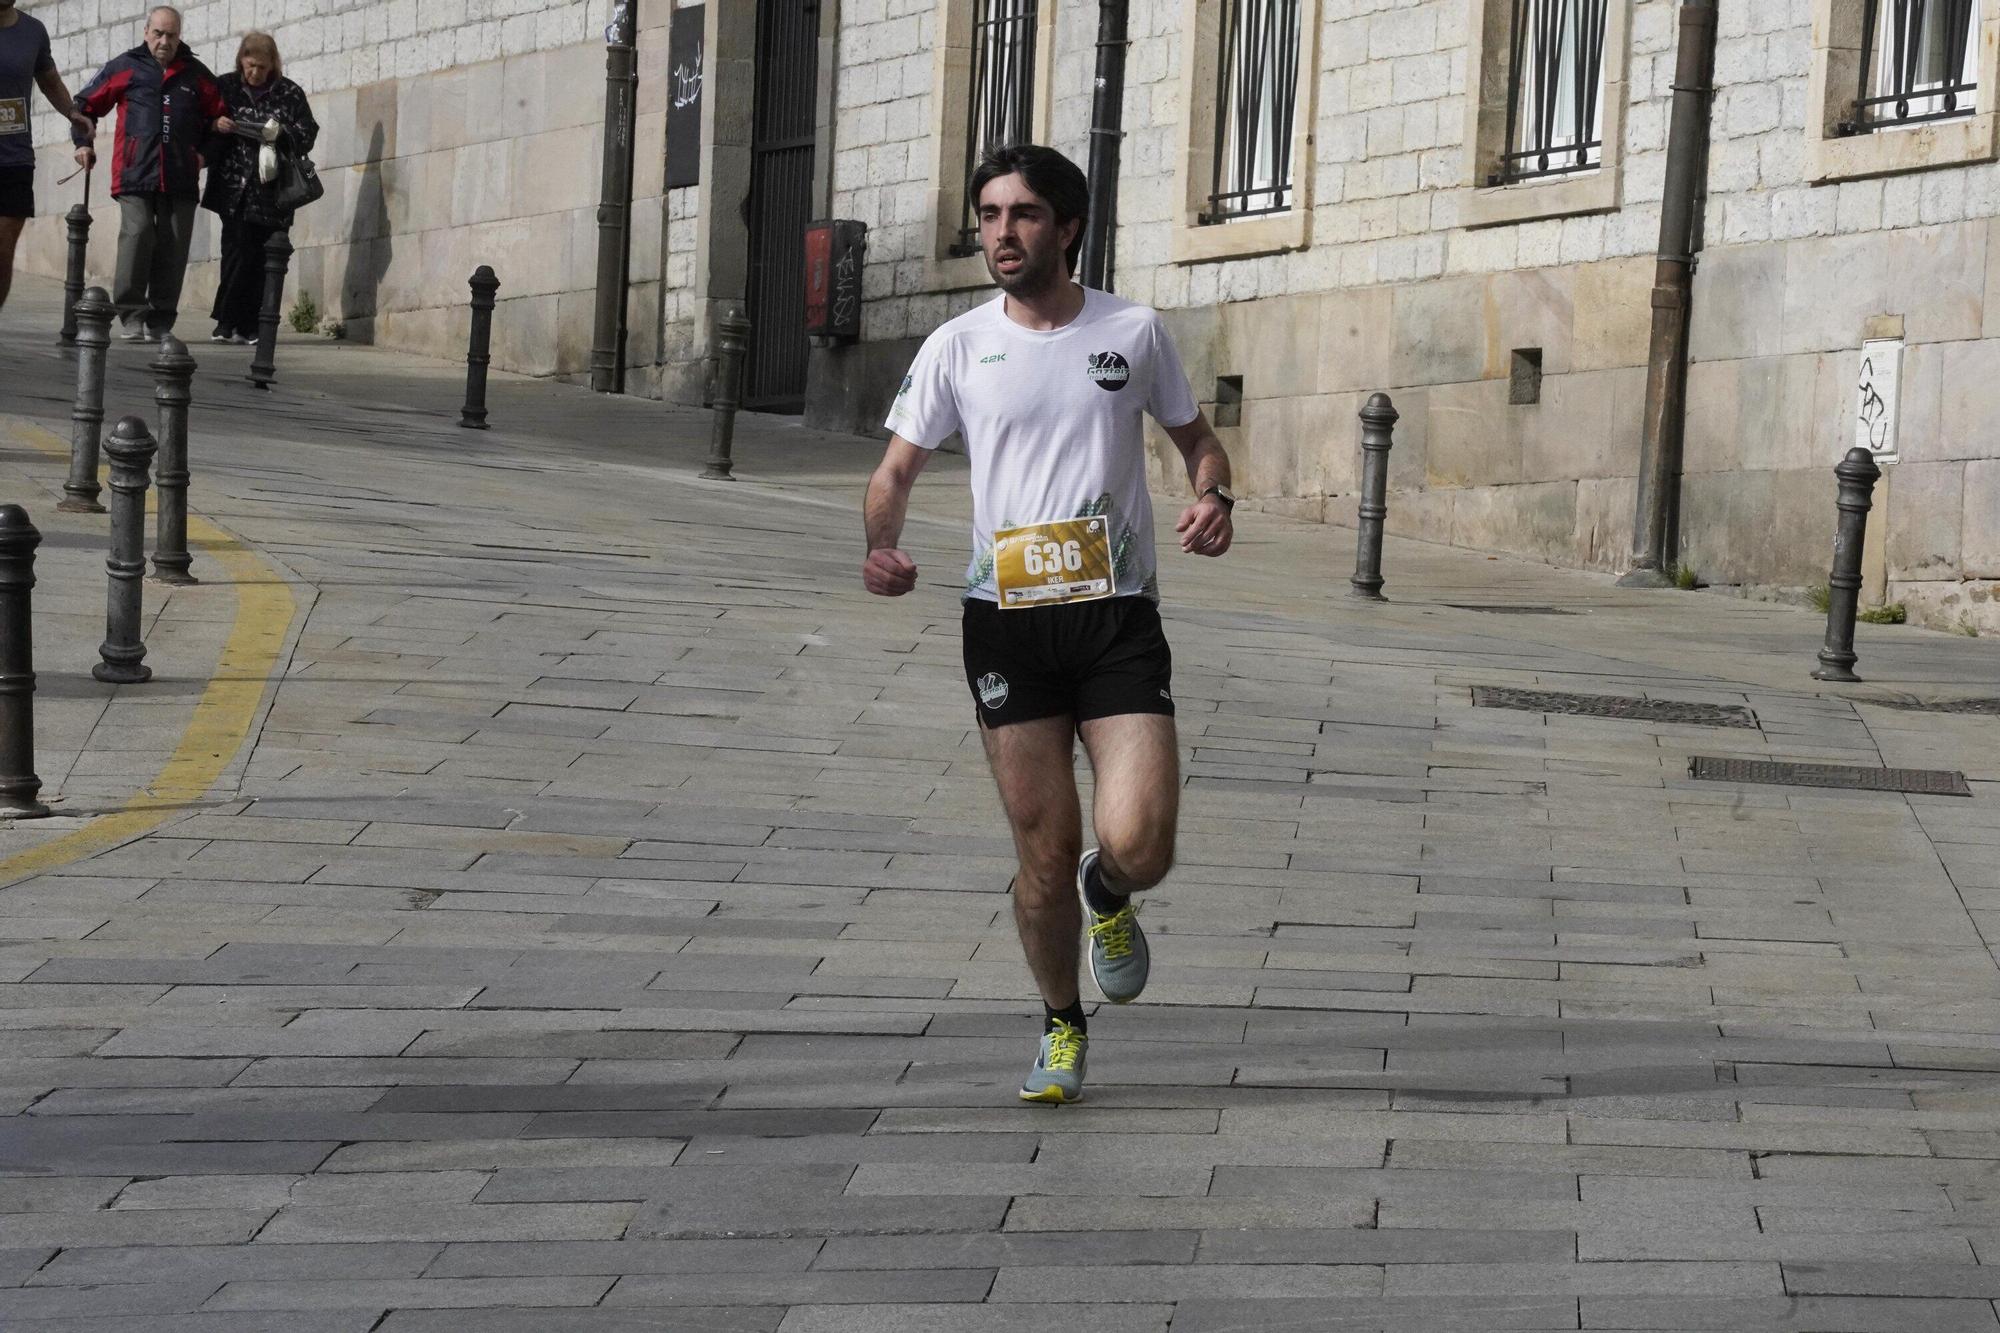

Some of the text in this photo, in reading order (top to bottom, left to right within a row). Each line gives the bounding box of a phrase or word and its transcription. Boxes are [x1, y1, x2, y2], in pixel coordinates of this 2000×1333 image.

[980, 352, 1007, 364] 42K
[1024, 540, 1082, 576] 636
[1047, 575, 1064, 585] IKER
